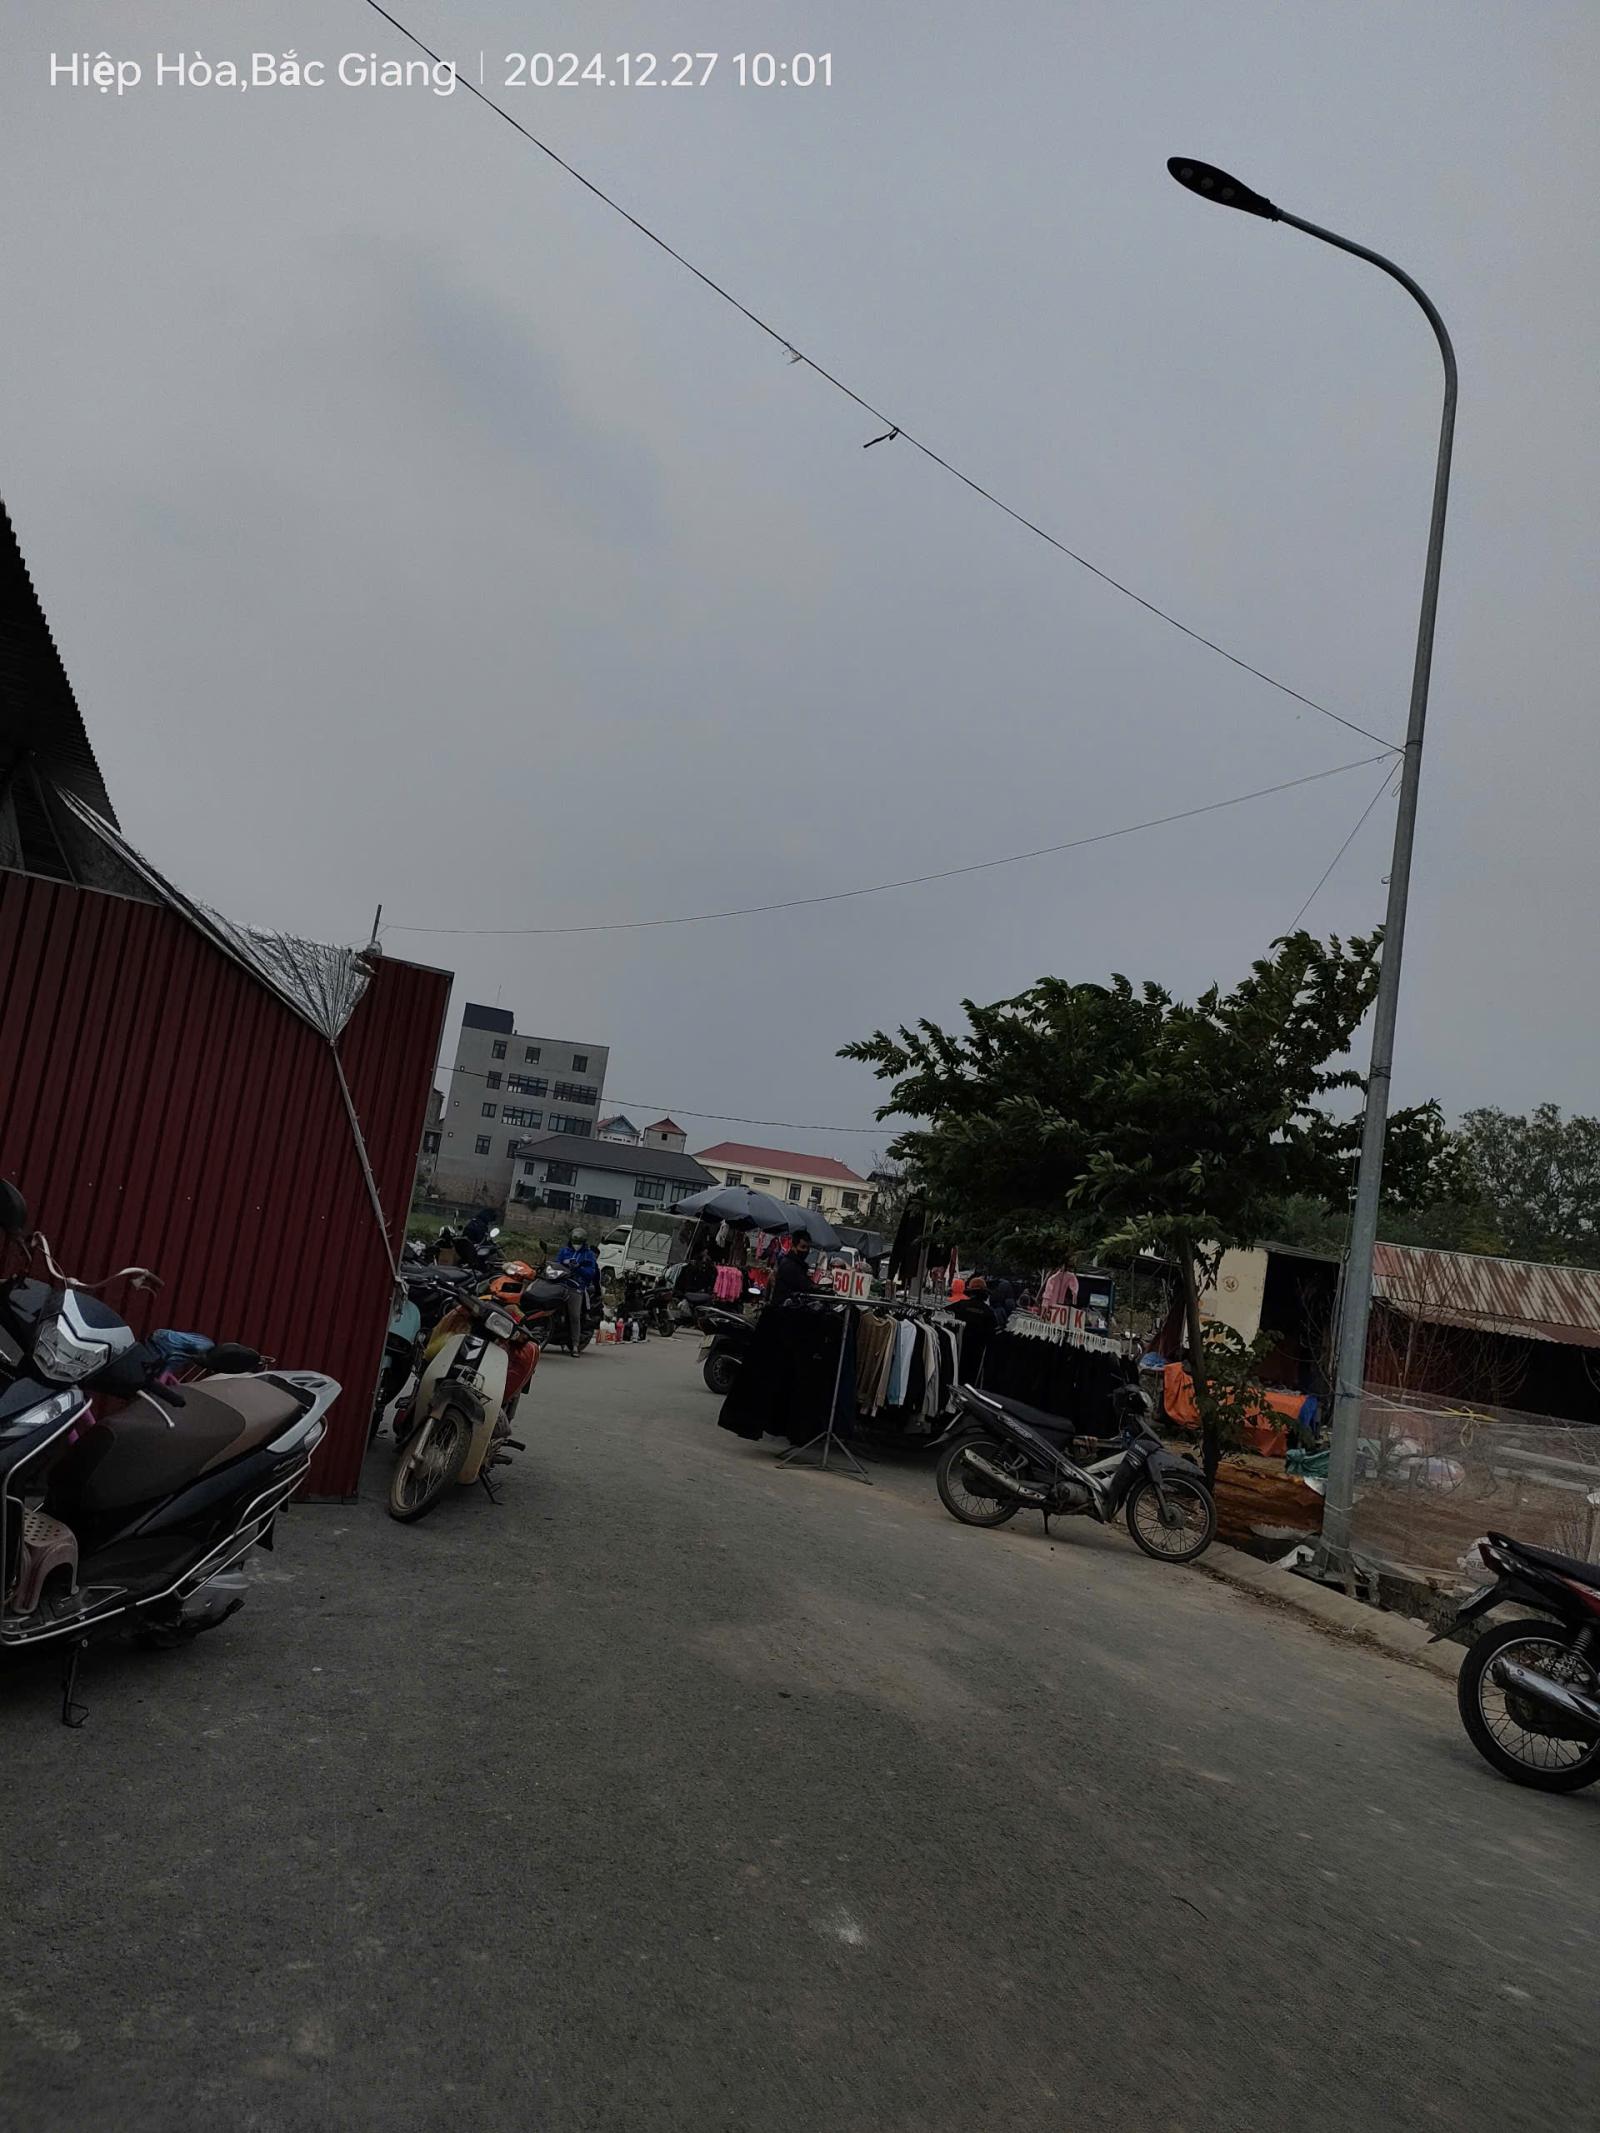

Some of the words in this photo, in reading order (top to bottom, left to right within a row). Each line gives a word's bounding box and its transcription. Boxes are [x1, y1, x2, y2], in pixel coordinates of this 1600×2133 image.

[834, 1271, 849, 1292] 50
[855, 1275, 864, 1296] K
[1075, 1310, 1083, 1329] K
